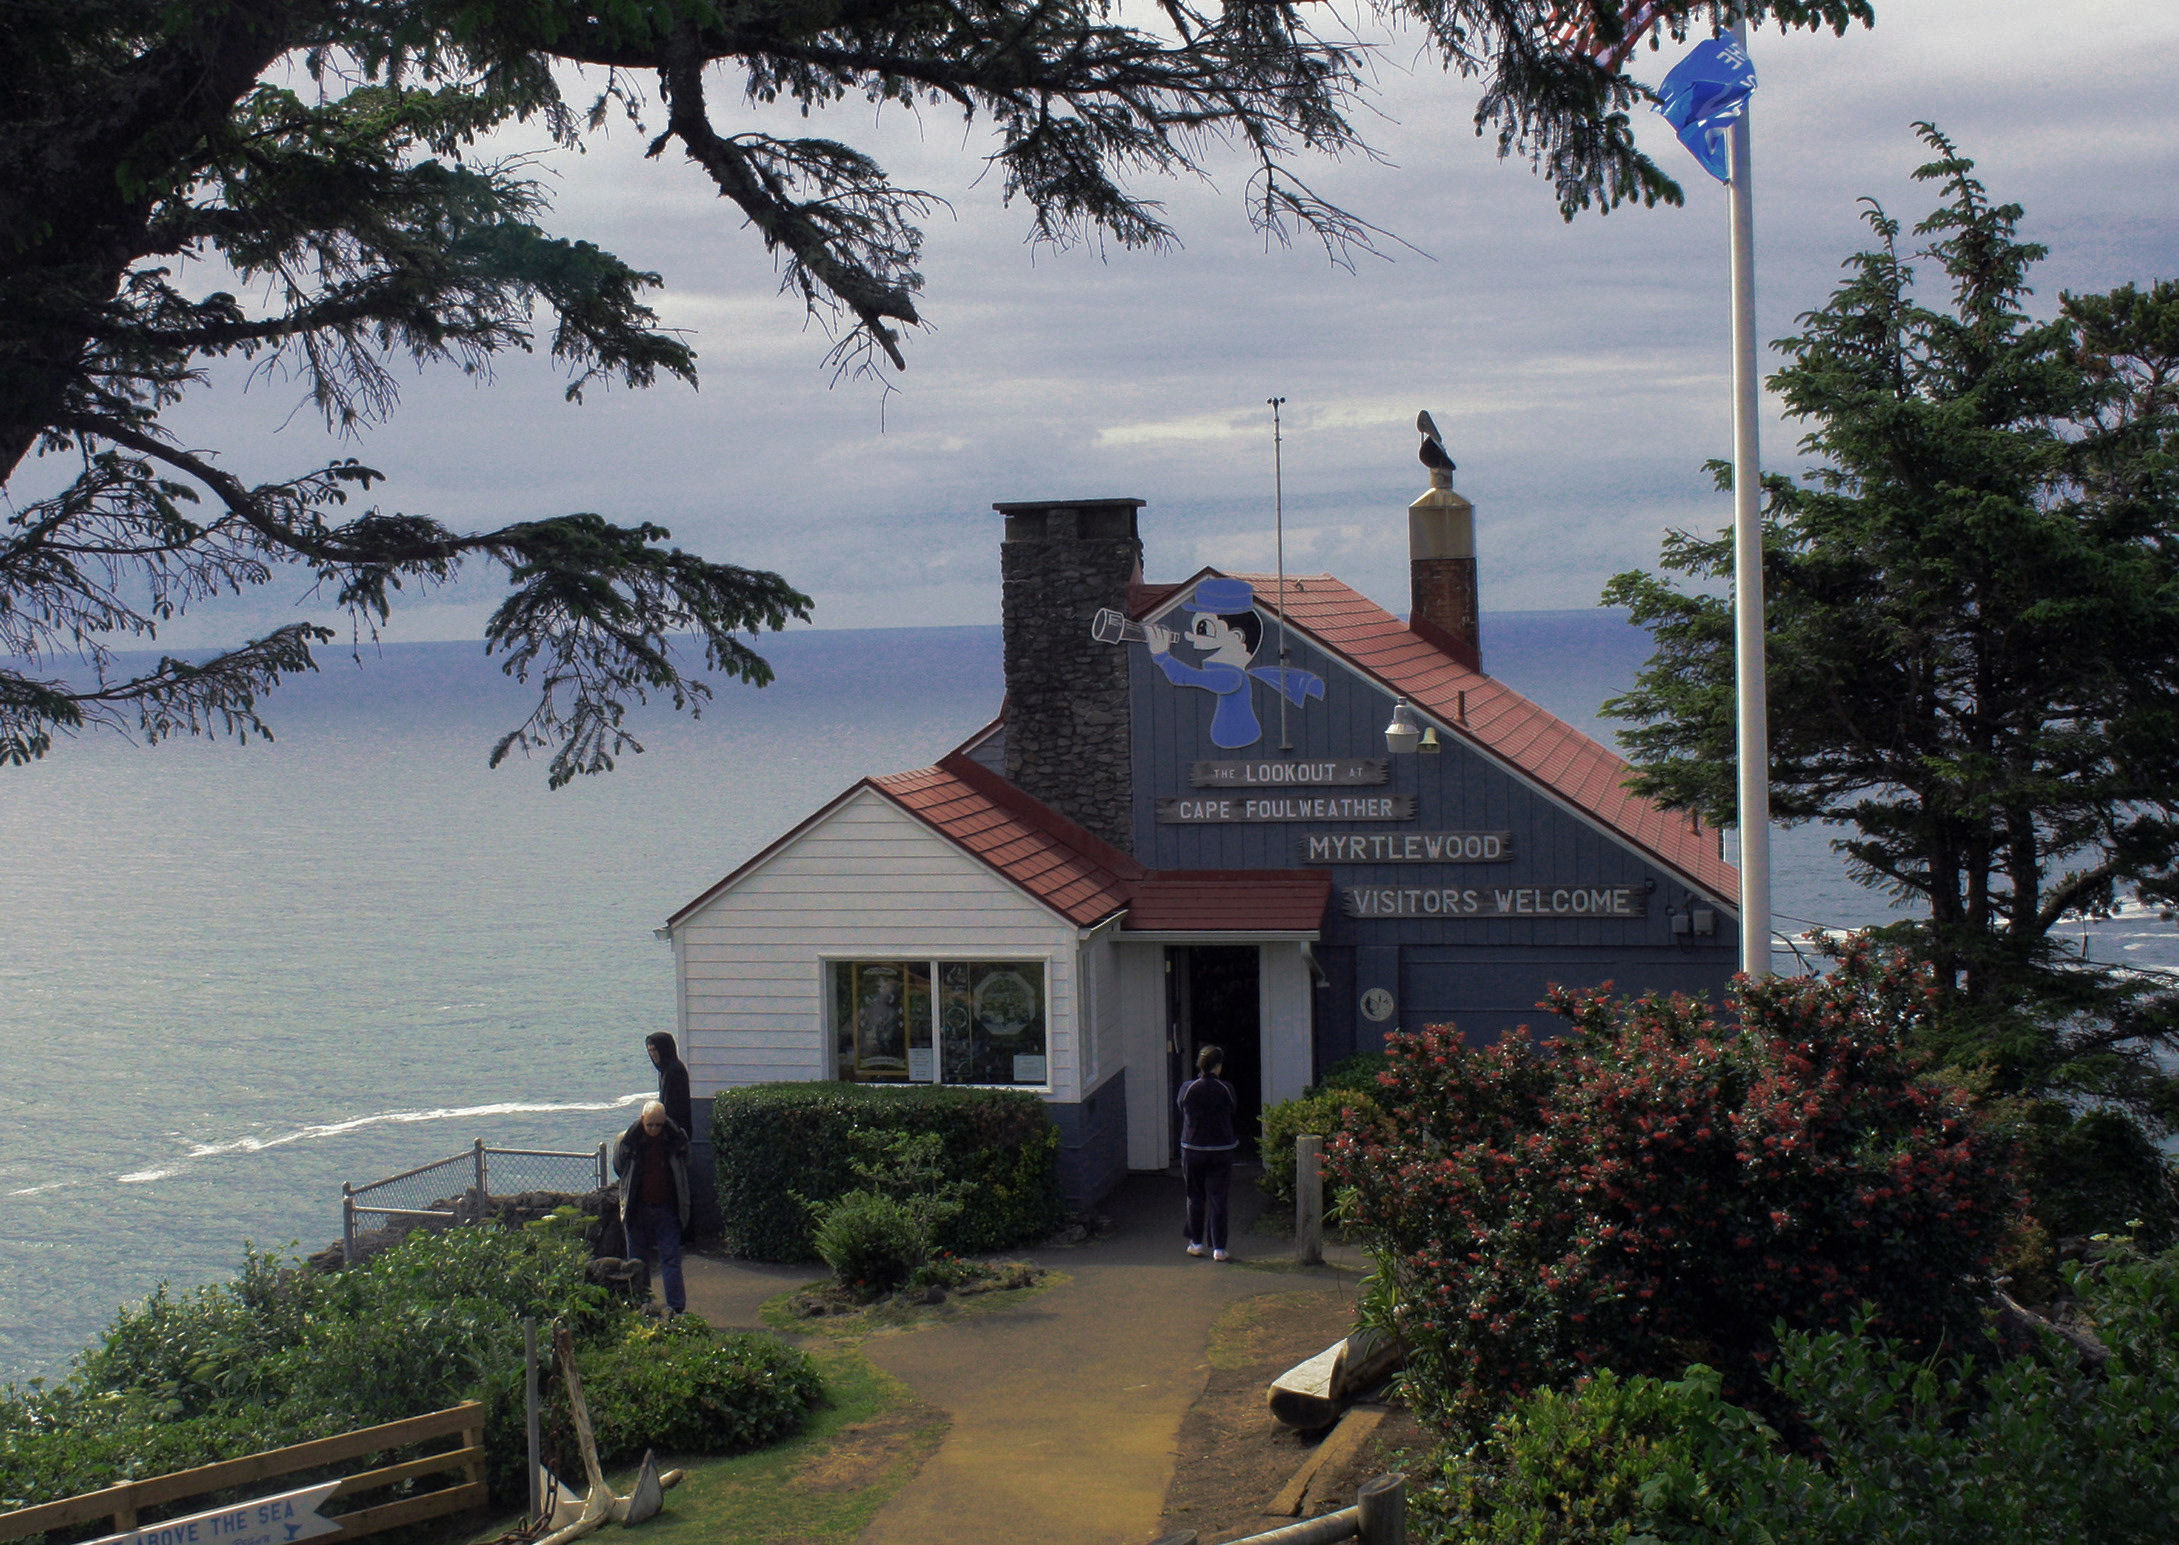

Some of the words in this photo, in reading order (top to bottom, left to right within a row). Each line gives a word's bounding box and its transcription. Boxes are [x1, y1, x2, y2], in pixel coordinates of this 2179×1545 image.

[1213, 769, 1235, 779] THE
[1246, 764, 1336, 782] LOOKOUT
[1349, 768, 1363, 777] AT
[1180, 801, 1230, 819] CAPE
[1246, 798, 1393, 818] FOULWEATHER
[1309, 836, 1500, 860] MYRTLEWOOD
[1353, 890, 1478, 913] VISITORS
[1495, 889, 1631, 913] WELCOME
[137, 1522, 201, 1545] ABOVE
[211, 1511, 248, 1536] THE
[259, 1501, 294, 1524] SEA
